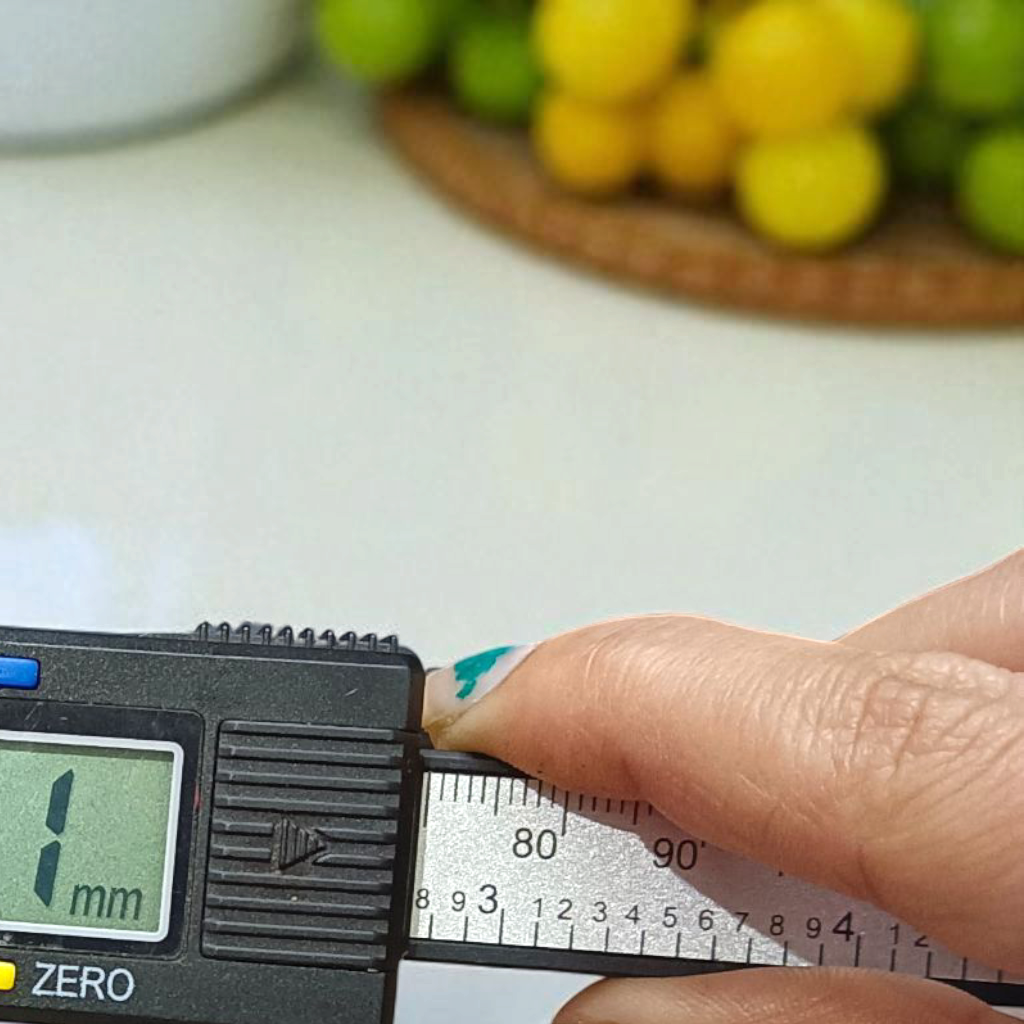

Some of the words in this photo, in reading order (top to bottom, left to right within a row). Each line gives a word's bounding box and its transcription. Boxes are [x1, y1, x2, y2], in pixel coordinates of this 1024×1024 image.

[512, 827, 557, 860] 80
[652, 837, 698, 871] 90
[69, 883, 143, 920] mm
[415, 888, 430, 910] 8
[451, 890, 466, 912] 9
[478, 884, 498, 914] 3
[533, 898, 543, 918] 1
[558, 899, 573, 920] 2
[592, 902, 607, 922] 3
[626, 904, 641, 924] 4
[662, 906, 677, 927] 5
[698, 909, 714, 931] 6
[735, 912, 749, 933] 7
[770, 914, 784, 936] 8
[806, 917, 821, 939] 9
[832, 911, 854, 942] 4
[889, 923, 900, 945] 1
[32, 961, 135, 1001] ZERO
